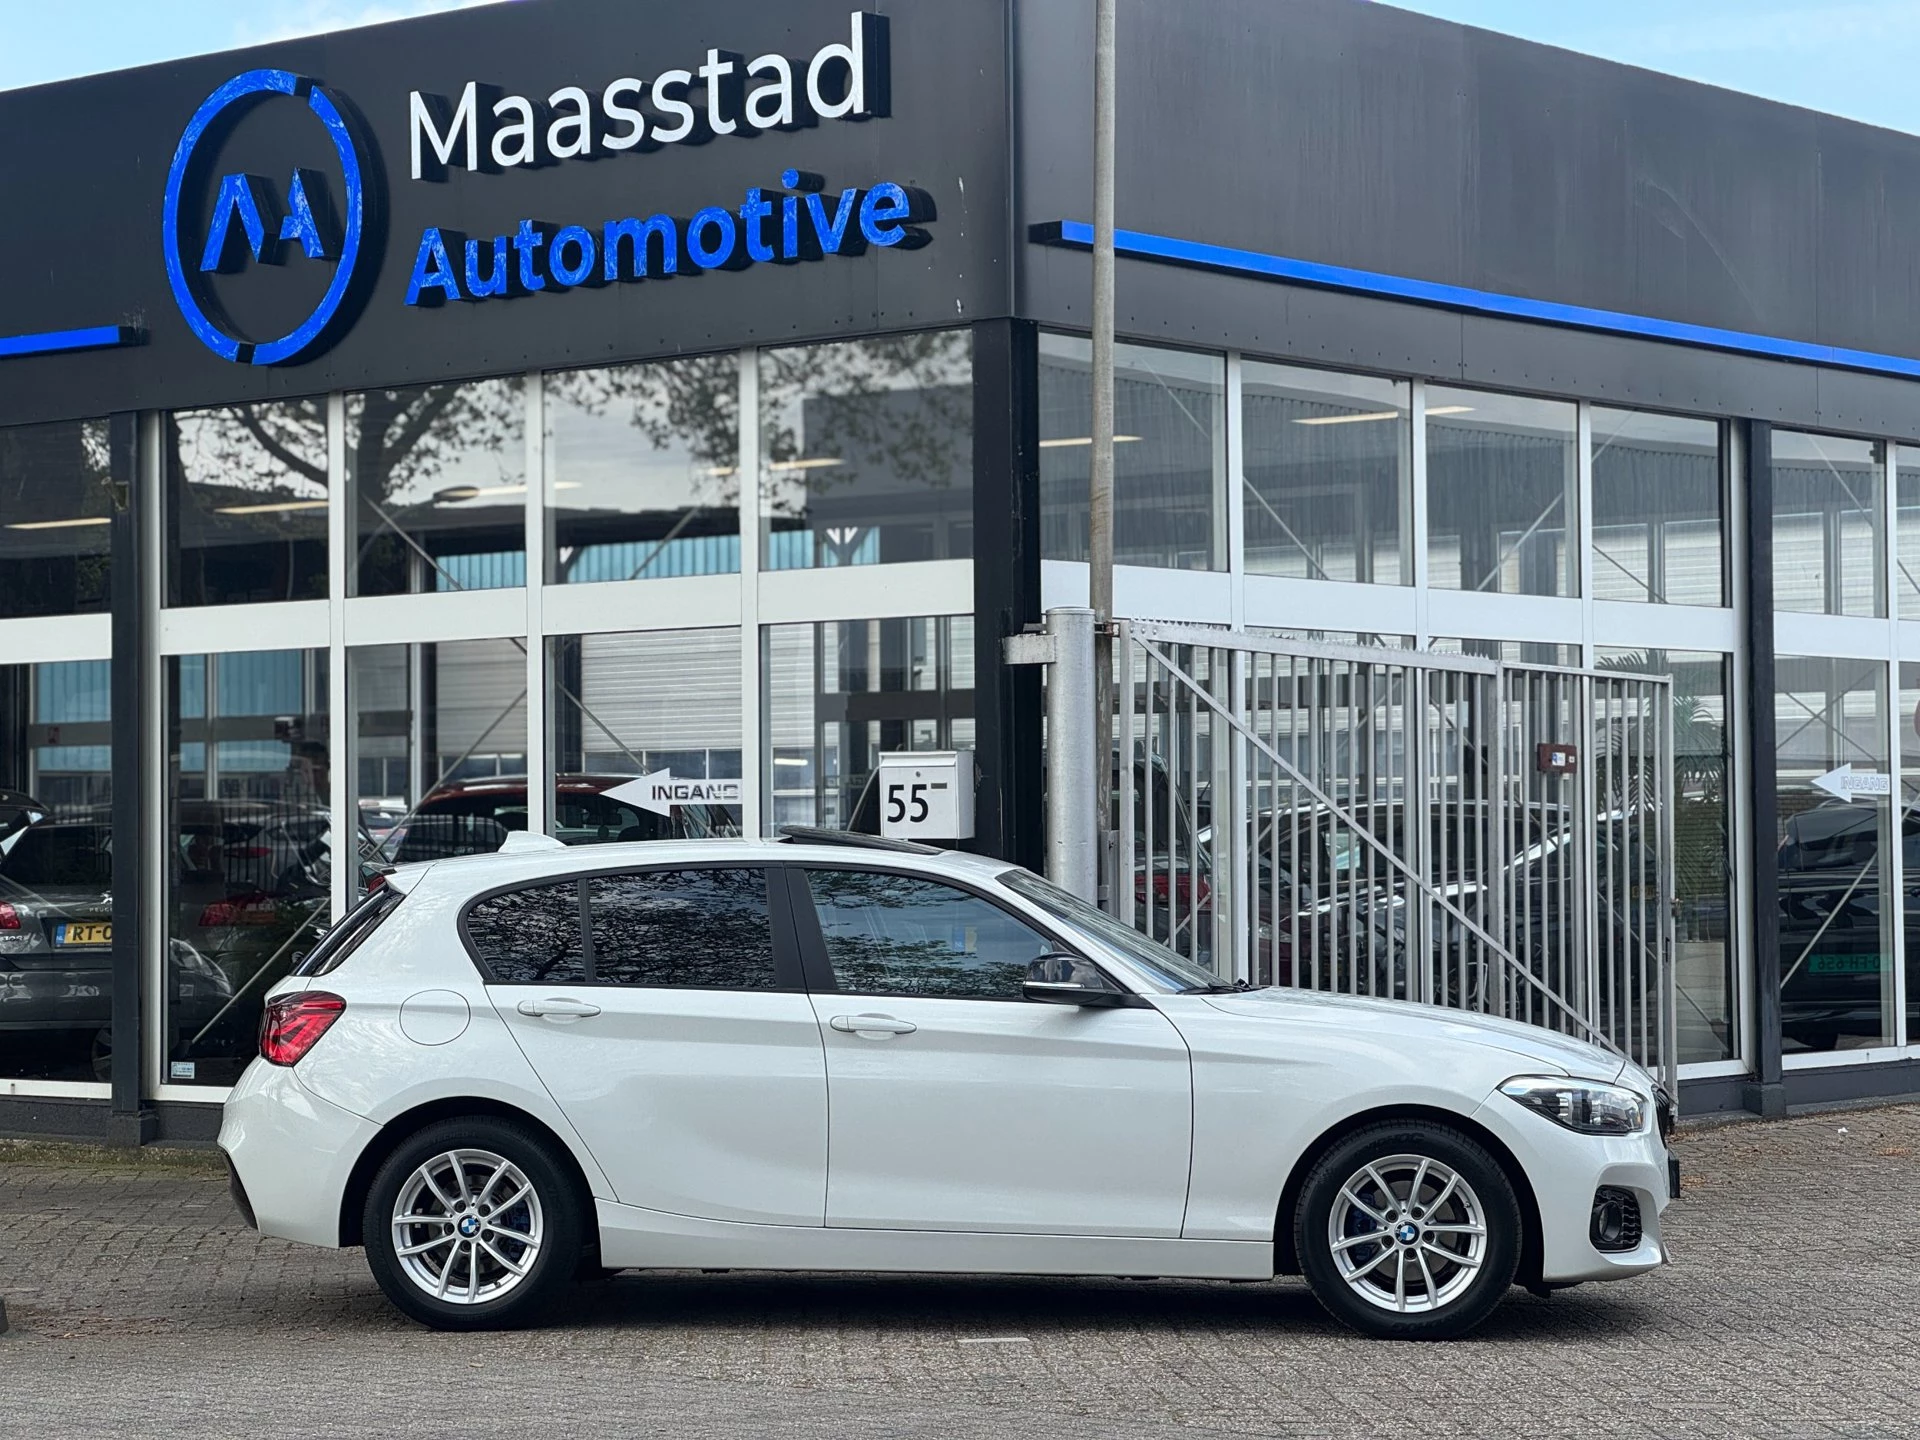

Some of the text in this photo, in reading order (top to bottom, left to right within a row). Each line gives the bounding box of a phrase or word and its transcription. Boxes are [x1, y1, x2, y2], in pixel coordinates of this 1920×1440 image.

[410, 11, 865, 180] Maasstad
[404, 168, 910, 305] Automotive
[887, 784, 929, 823] 55
[1840, 775, 1889, 791] INGANG
